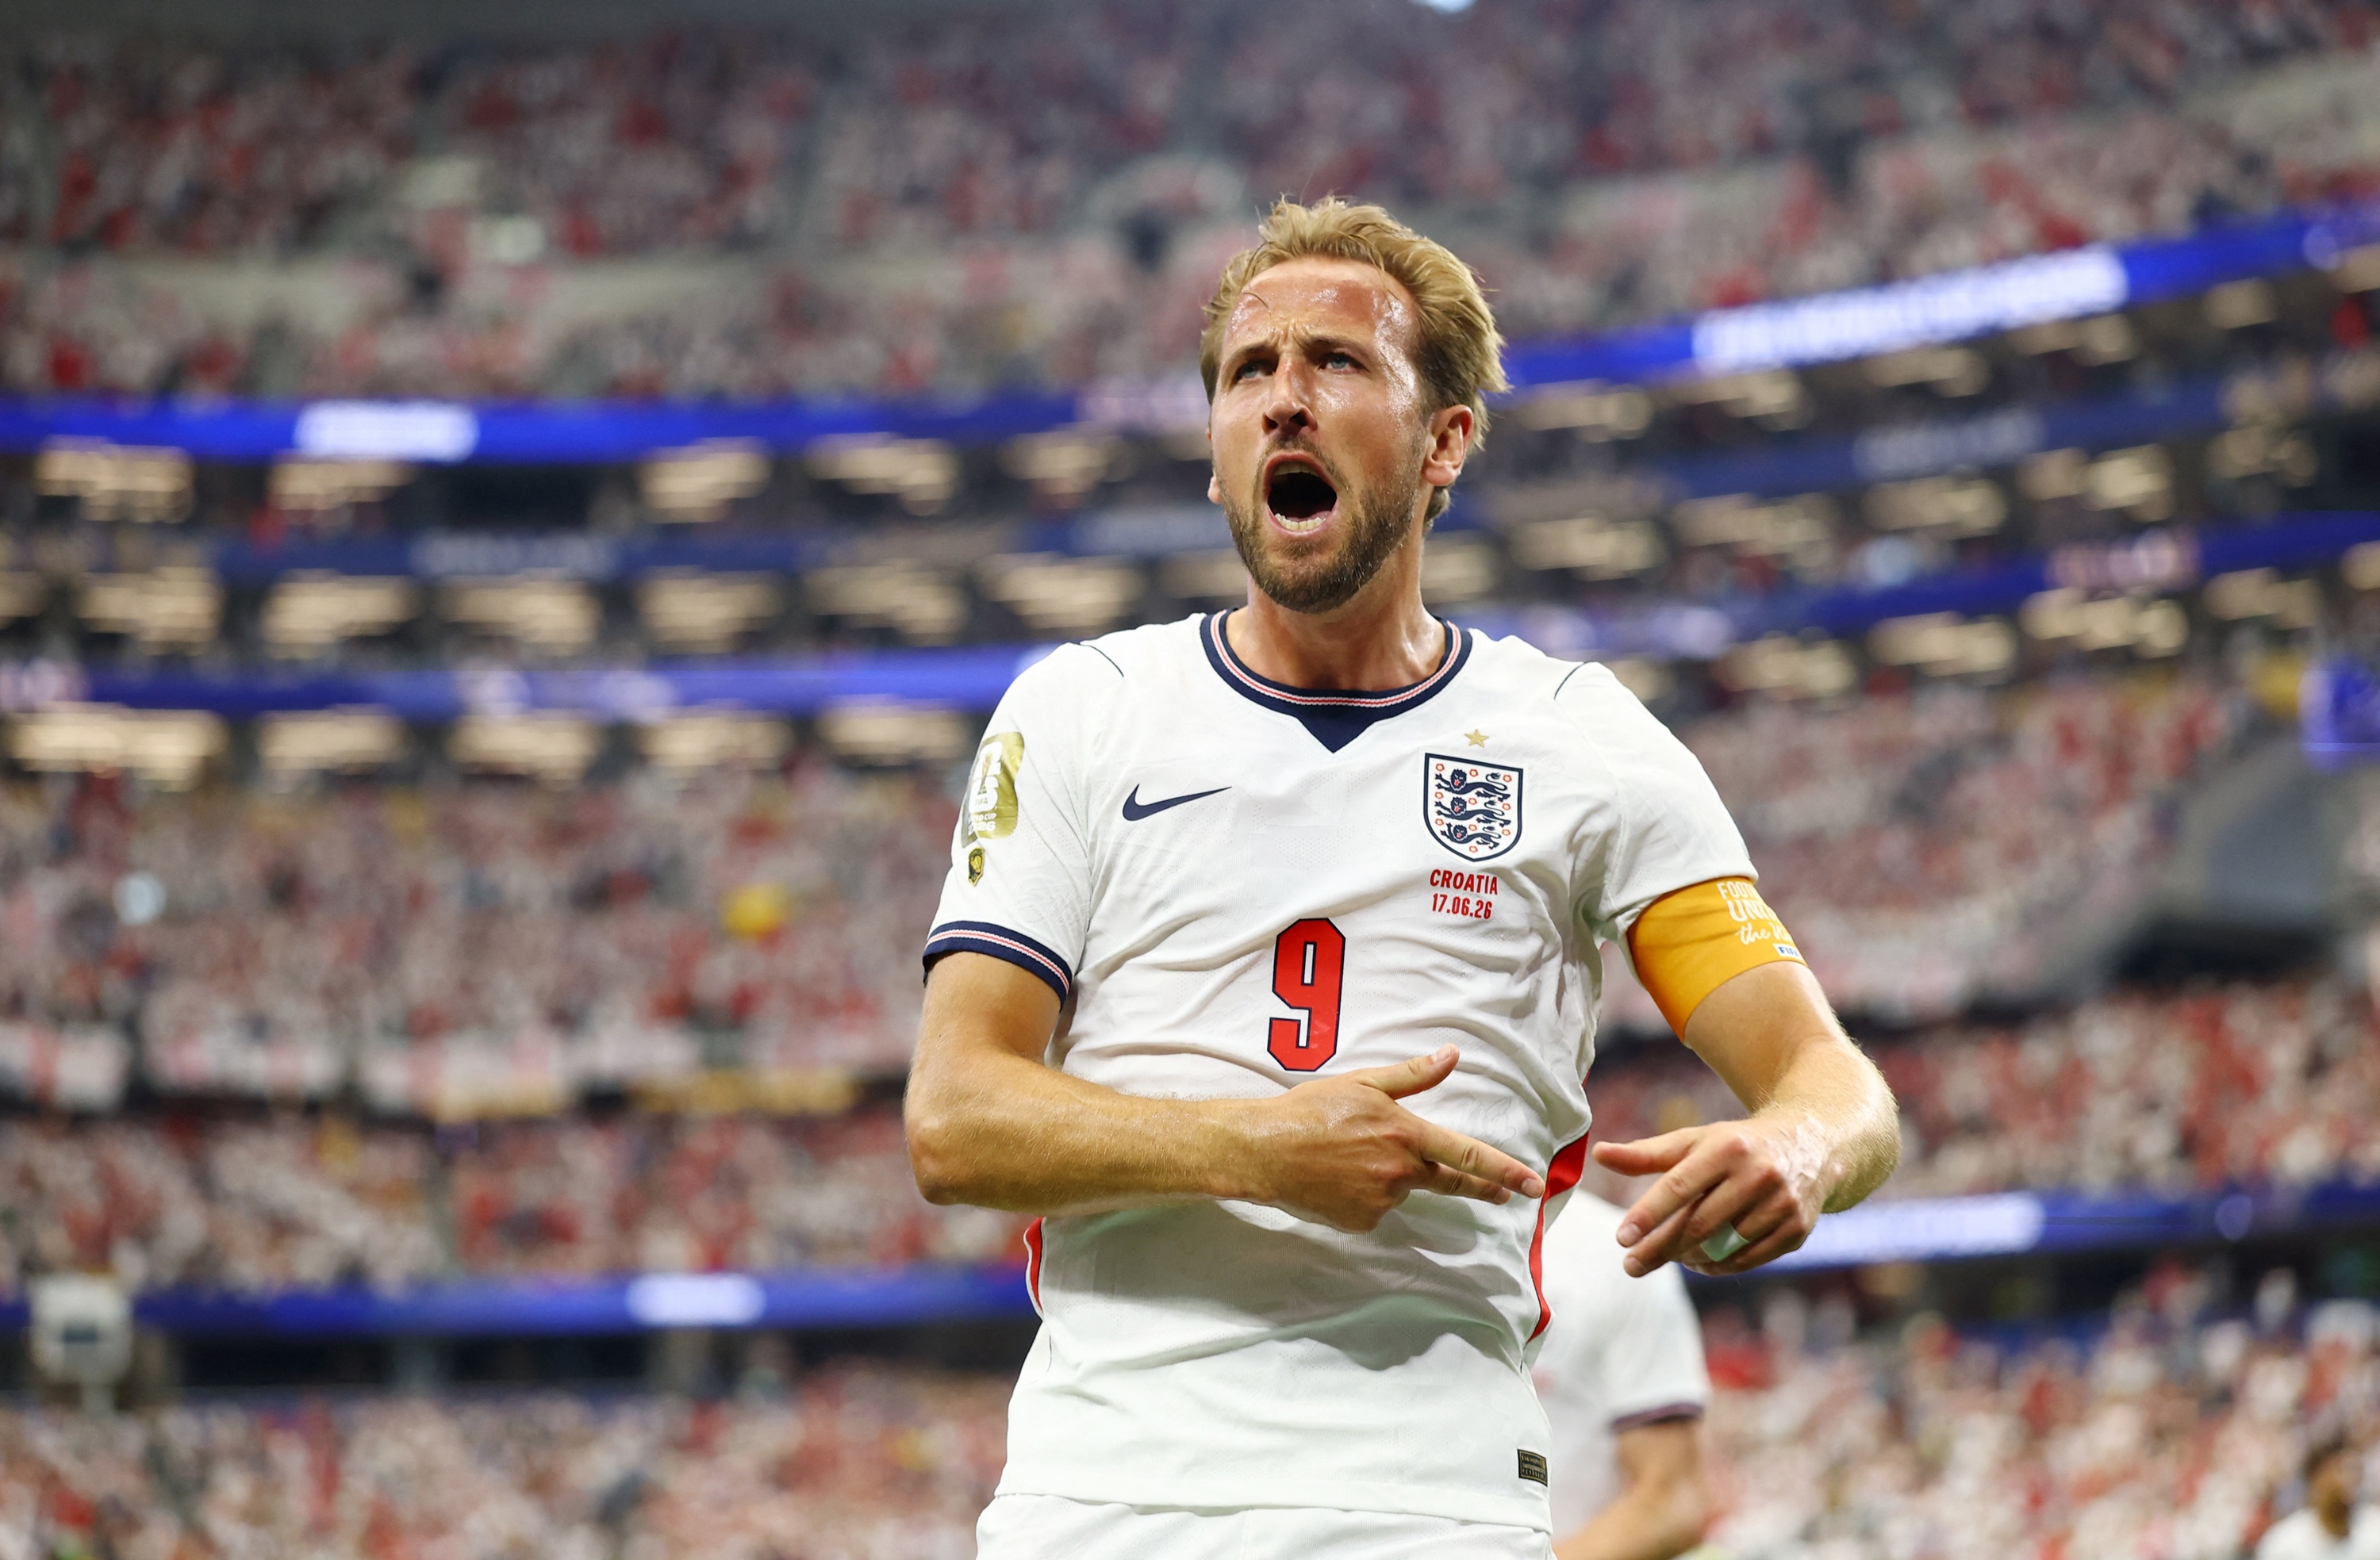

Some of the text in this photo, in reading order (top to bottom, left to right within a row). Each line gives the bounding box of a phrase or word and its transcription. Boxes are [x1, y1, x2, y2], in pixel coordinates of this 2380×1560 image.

[975, 797, 988, 806] FIFA
[984, 812, 997, 821] CUP
[1430, 869, 1498, 895] CROATIA
[1432, 893, 1493, 920] 17.06.26
[1735, 922, 1771, 945] the
[1267, 918, 1345, 1071] 9
